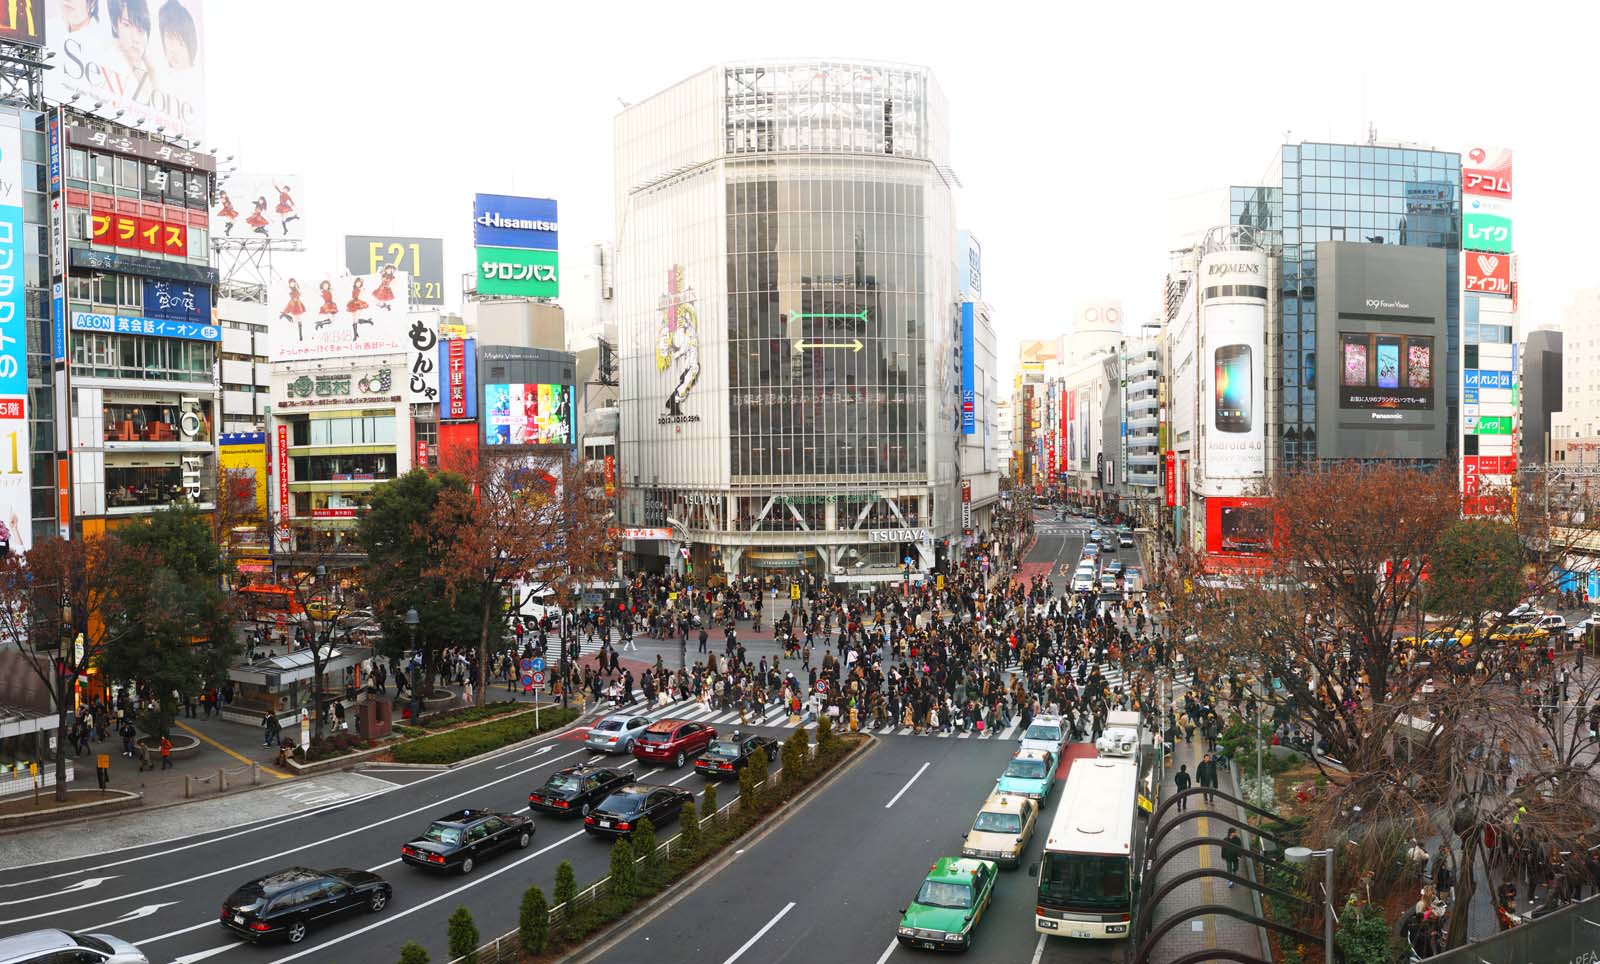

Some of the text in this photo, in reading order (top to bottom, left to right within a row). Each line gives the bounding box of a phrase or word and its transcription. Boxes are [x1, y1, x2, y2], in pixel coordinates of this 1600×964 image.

[1467, 173, 1511, 193] アコム
[477, 211, 558, 233] Hisamitsu
[1467, 223, 1509, 241] レイク
[481, 262, 557, 281] サロンパス
[424, 283, 440, 299] 21
[1466, 275, 1508, 291] アイフル
[1365, 299, 1379, 309] 109
[76, 314, 110, 329] AEON
[118, 319, 198, 336] 英会話イーオン
[408, 320, 438, 400] もんじゃ
[450, 339, 464, 414] 三千里薬品
[1480, 421, 1498, 429] レイク
[1249, 440, 1262, 450] 4.0
[683, 495, 720, 505] TSUTAYA
[774, 495, 836, 504] STARBUCKS
[872, 530, 926, 542] TSUTAYA
